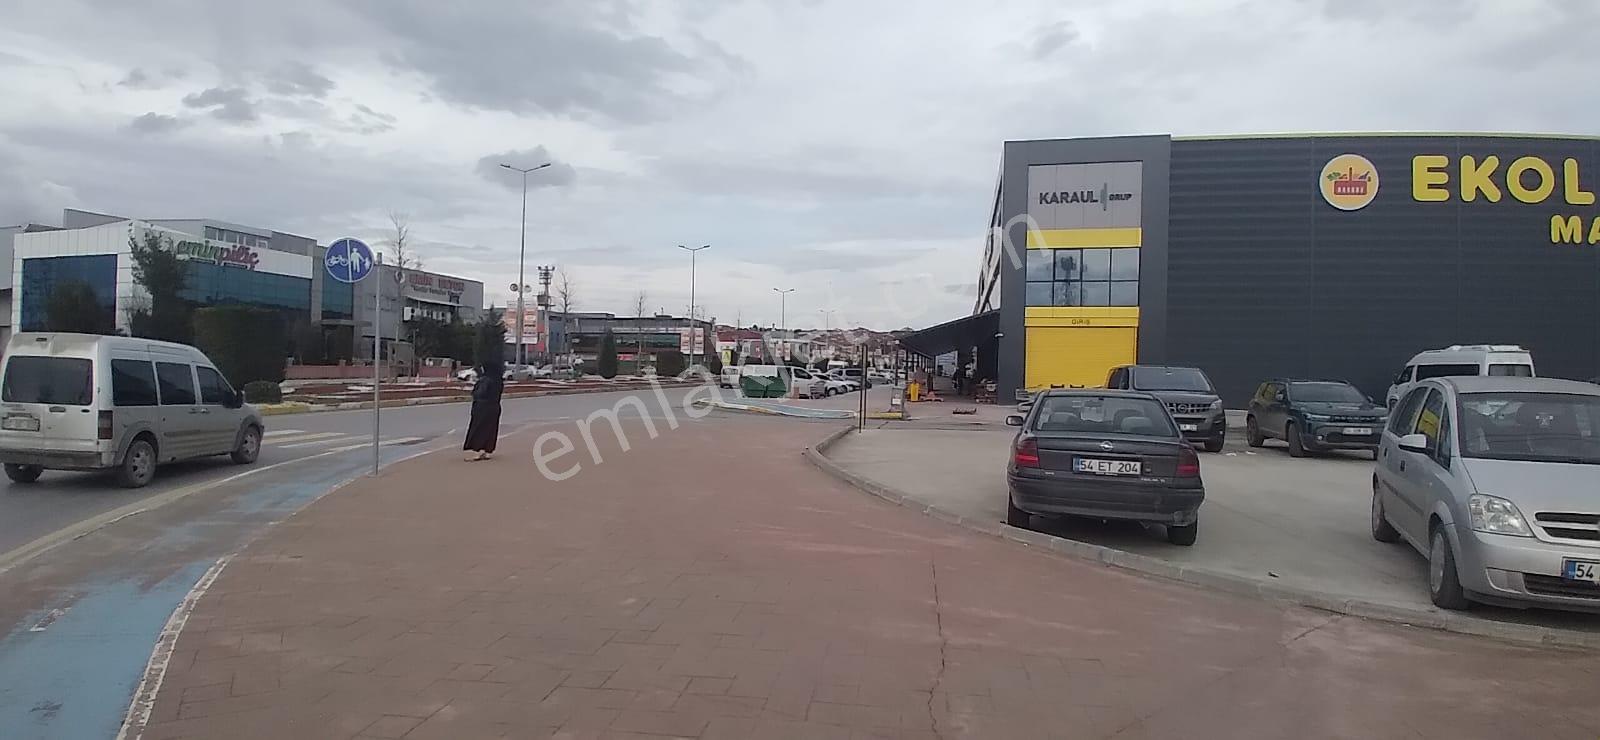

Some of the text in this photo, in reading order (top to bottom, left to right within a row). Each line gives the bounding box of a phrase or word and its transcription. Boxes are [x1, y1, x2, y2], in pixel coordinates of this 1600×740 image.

[1411, 154, 1596, 205] EKOL
[1039, 190, 1132, 205] KARAUL GRUP
[1080, 460, 1138, 473] 54 ET 204
[1575, 564, 1594, 579] 54
